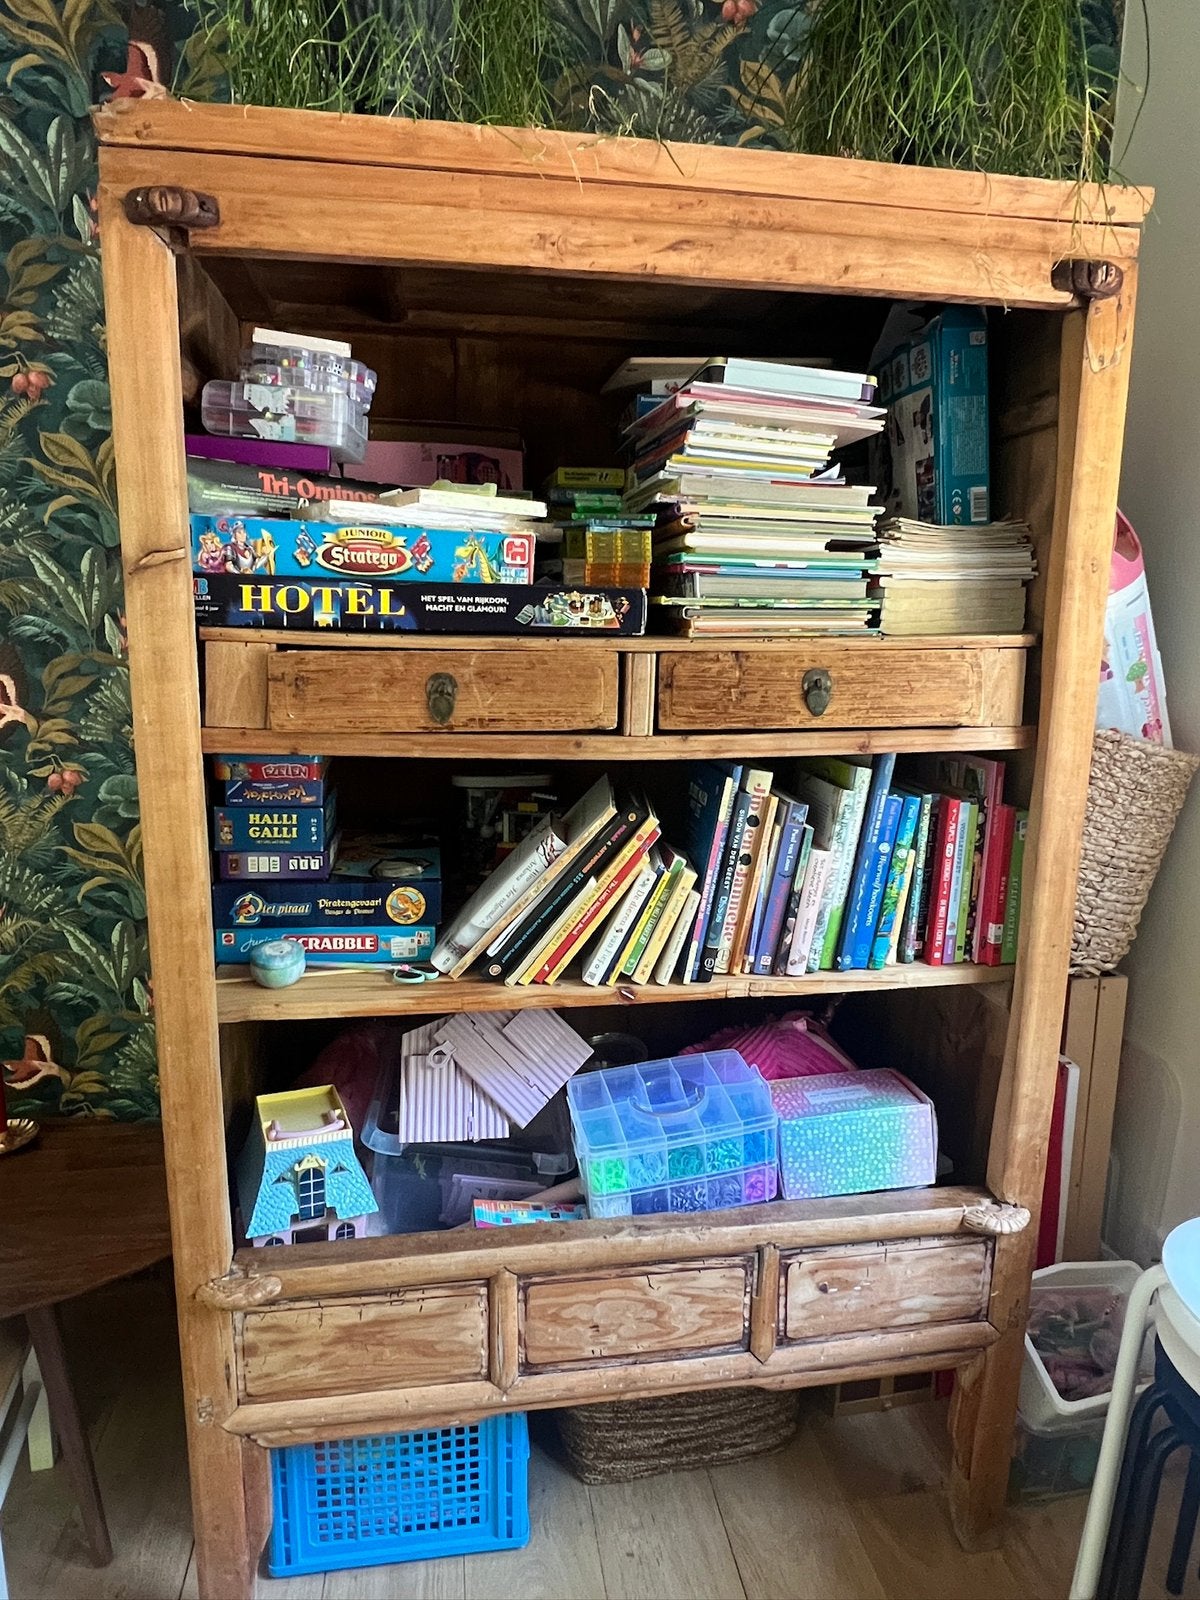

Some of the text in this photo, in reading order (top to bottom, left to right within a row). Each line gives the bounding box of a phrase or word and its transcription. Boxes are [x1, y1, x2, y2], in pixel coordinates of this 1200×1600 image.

[258, 472, 378, 502] Tri-Ominos
[342, 529, 387, 540] JUNIOR
[330, 546, 398, 570] Stratego
[238, 584, 406, 616] HOTEL
[421, 595, 509, 605] HET SPEL VAN RIJKDOM,
[425, 604, 507, 613] MACHT EN GLAMOUR!
[749, 782, 767, 812] Jip
[248, 814, 298, 825] HALLI
[734, 808, 745, 832] SIMON
[248, 826, 298, 838] GALLI
[731, 833, 740, 848] VAN
[741, 827, 755, 851] en
[728, 850, 736, 865] DER
[783, 828, 799, 871] Paul van Loon
[723, 866, 733, 889] GEEST
[633, 889, 644, 901] De
[721, 867, 749, 942] Janneke
[619, 900, 638, 927] dieren
[290, 936, 376, 951] CRABBLE
[606, 934, 618, 949] van
